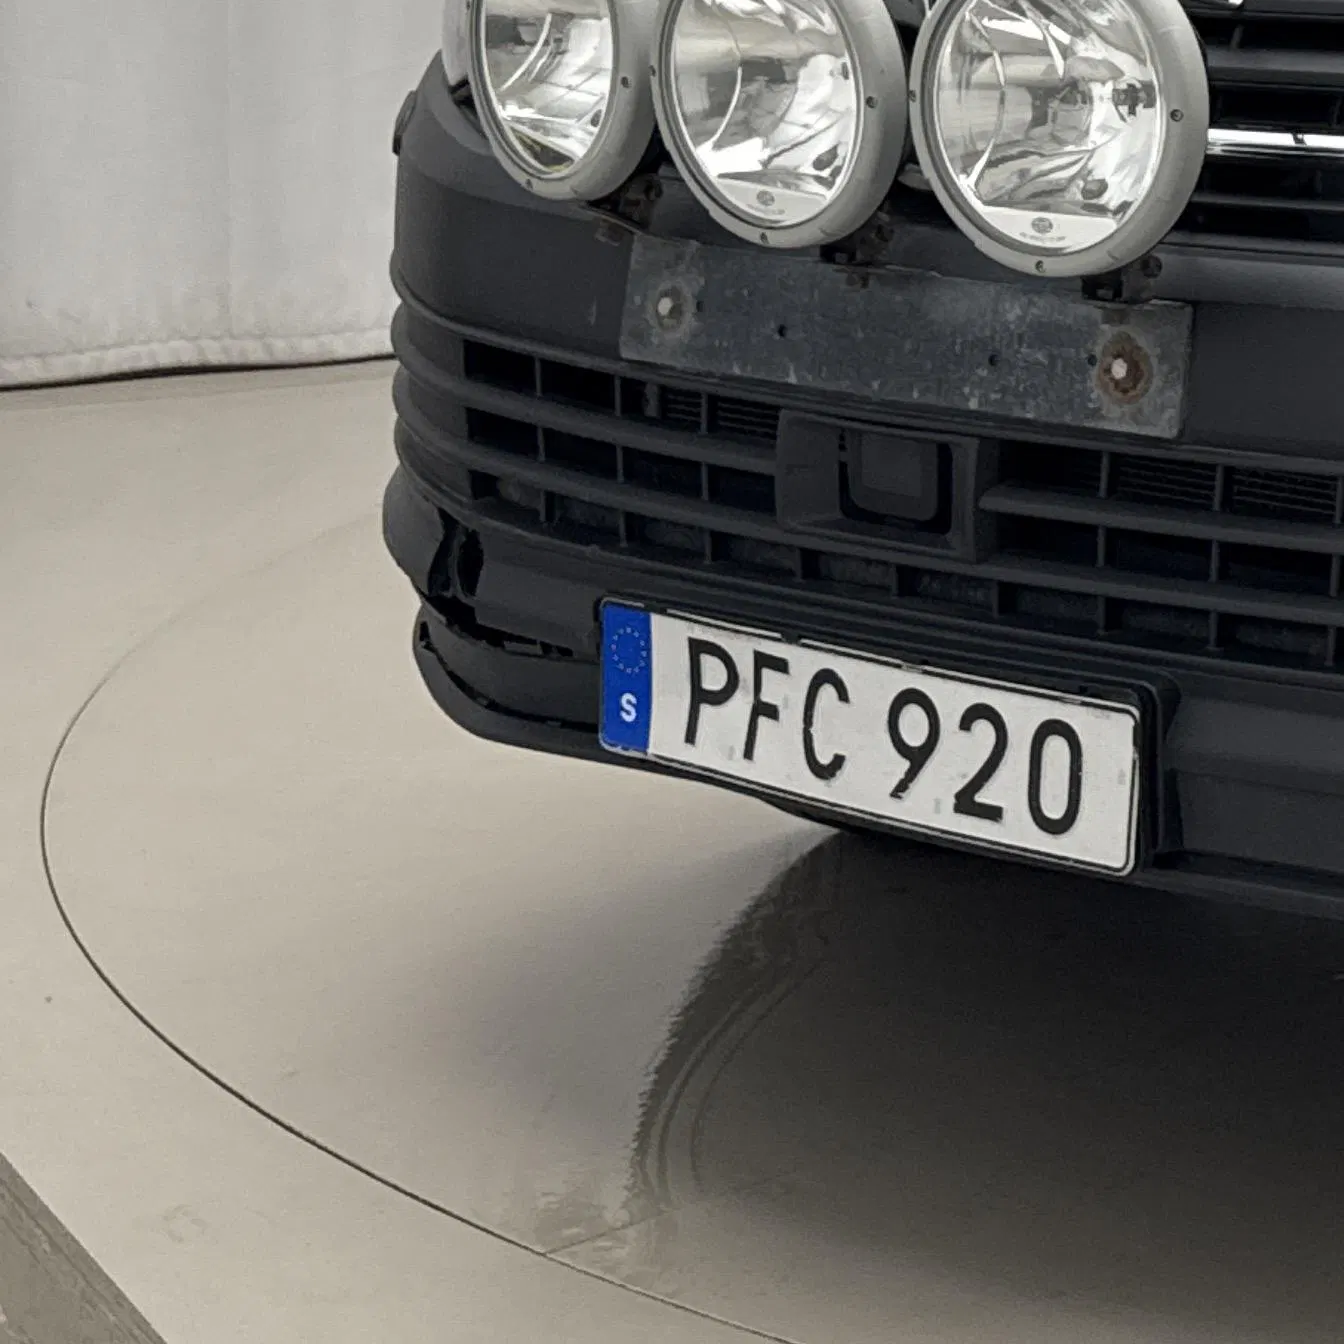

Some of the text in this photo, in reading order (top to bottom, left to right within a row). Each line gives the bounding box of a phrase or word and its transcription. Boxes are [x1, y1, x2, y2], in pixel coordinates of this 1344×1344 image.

[619, 692, 637, 722] S
[684, 636, 1083, 836] PFC 920
